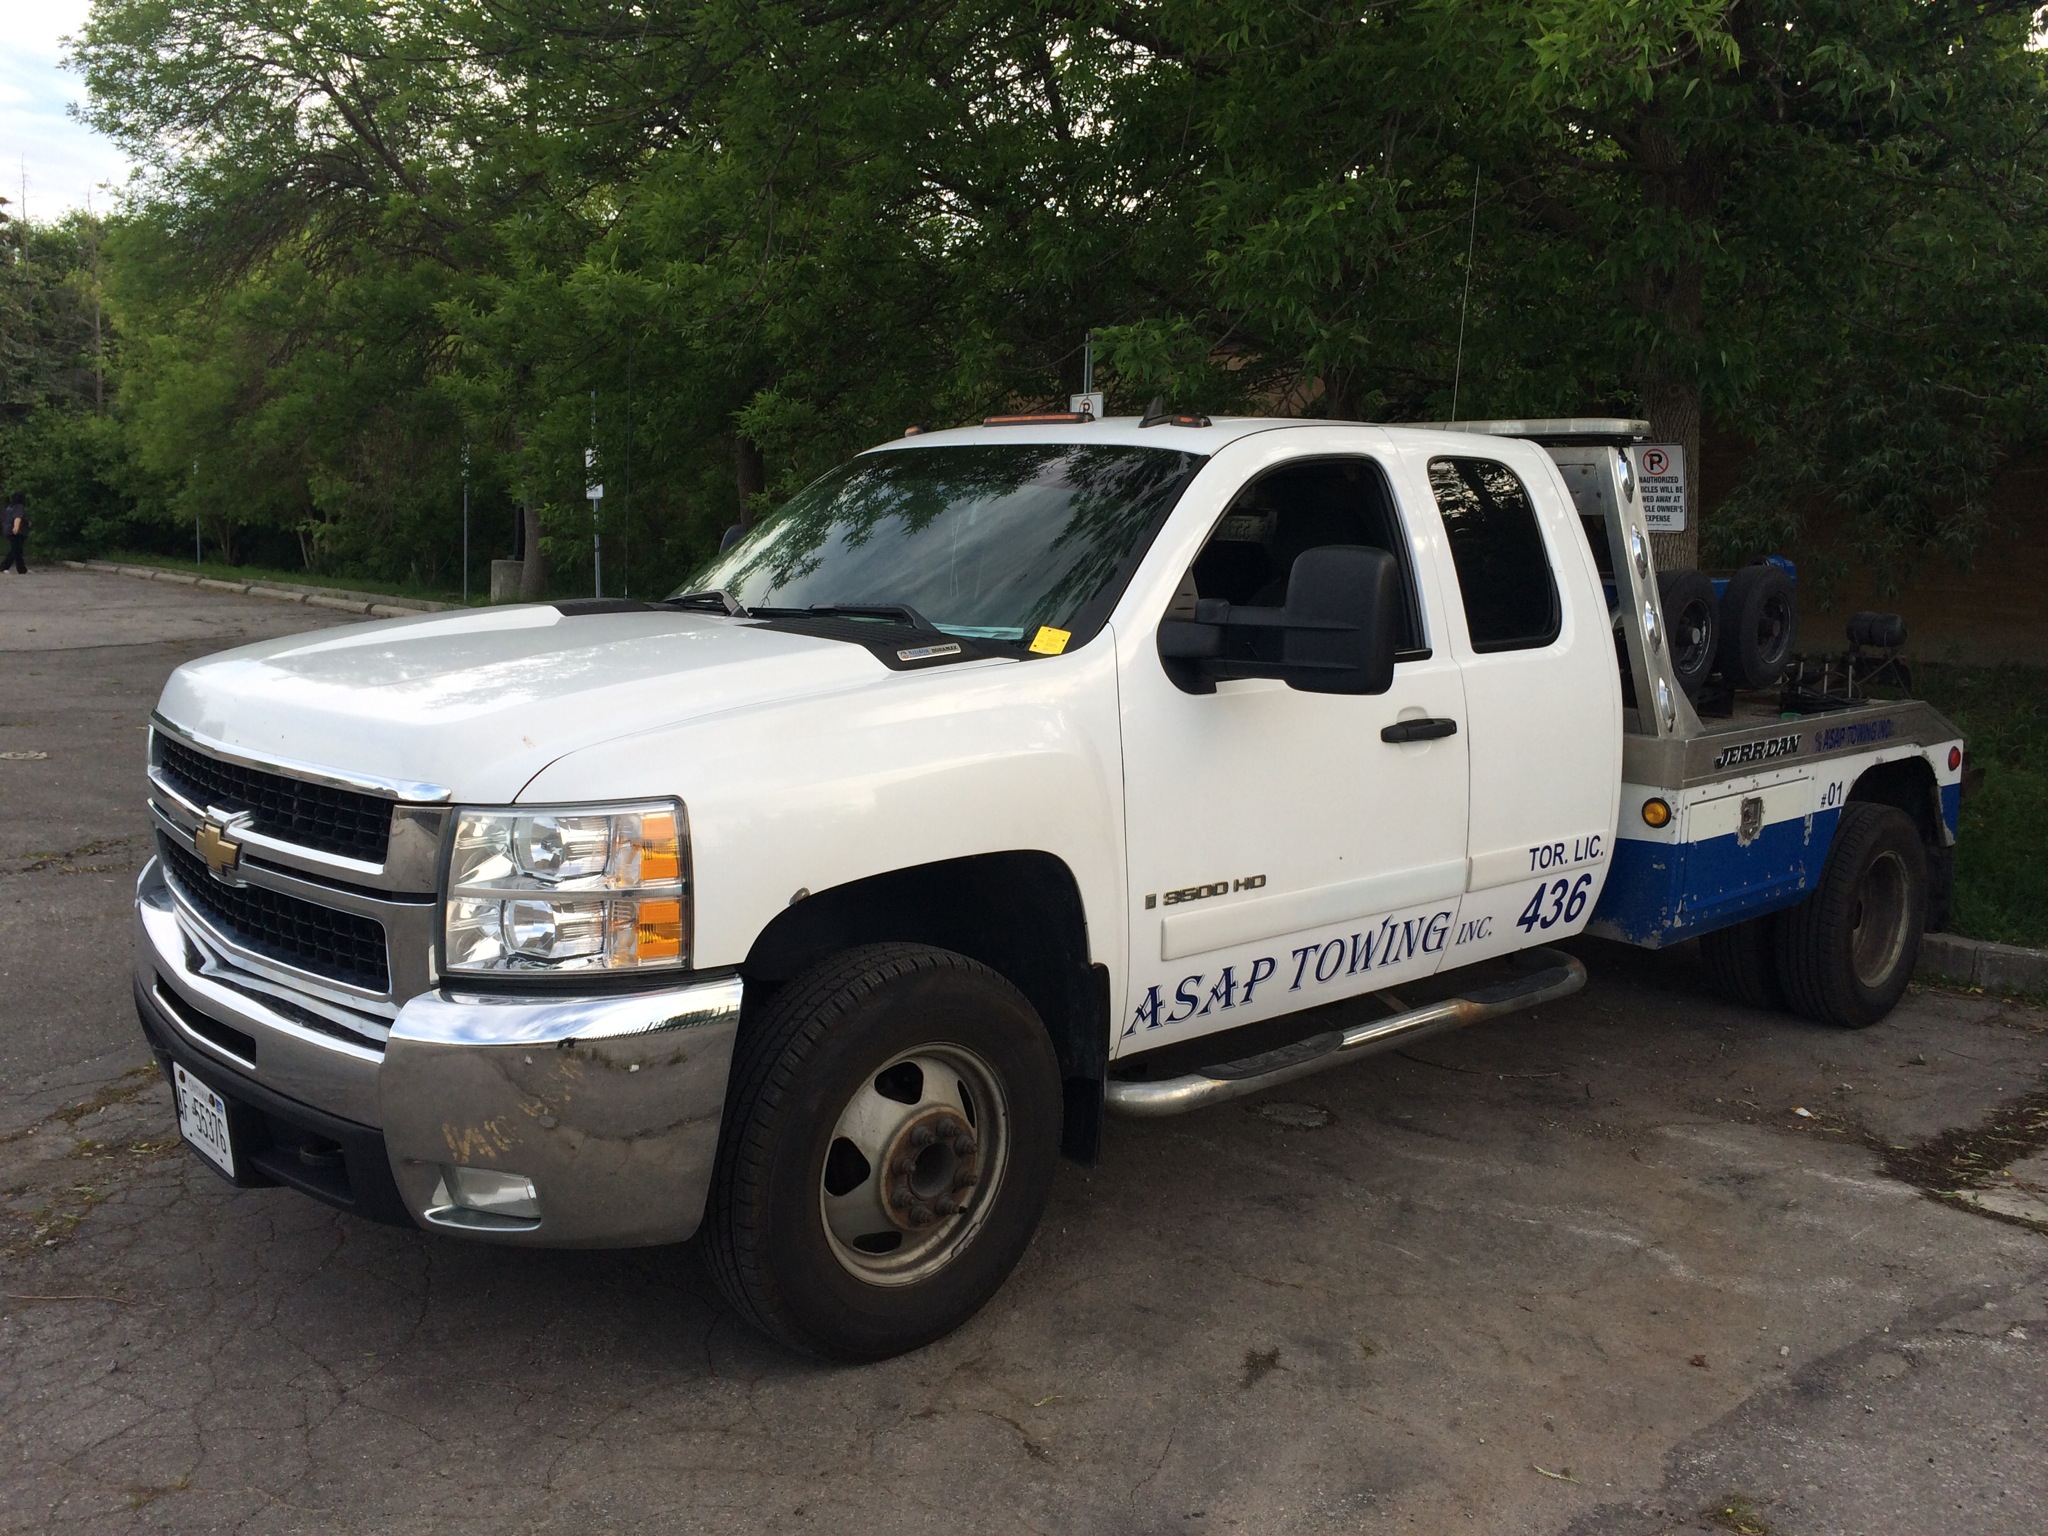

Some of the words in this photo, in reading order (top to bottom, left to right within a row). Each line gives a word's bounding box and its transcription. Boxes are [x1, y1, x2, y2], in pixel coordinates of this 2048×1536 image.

[1655, 495, 1672, 503] AWAY
[1656, 505, 1684, 513] OWNER'S
[1645, 514, 1671, 522] EXPENSE
[1823, 727, 1846, 750] ASAP
[1820, 780, 1843, 808] #01
[1529, 842, 1568, 871] TOR.
[1574, 835, 1604, 862] LIC.
[1163, 881, 1229, 906] 3500
[1233, 874, 1266, 892] HD
[1516, 873, 1592, 933] 436
[1120, 955, 1279, 1039] ASAP
[1288, 911, 1452, 992] TOWING
[1455, 916, 1493, 946] INC.
[192, 1096, 227, 1155] 55376
